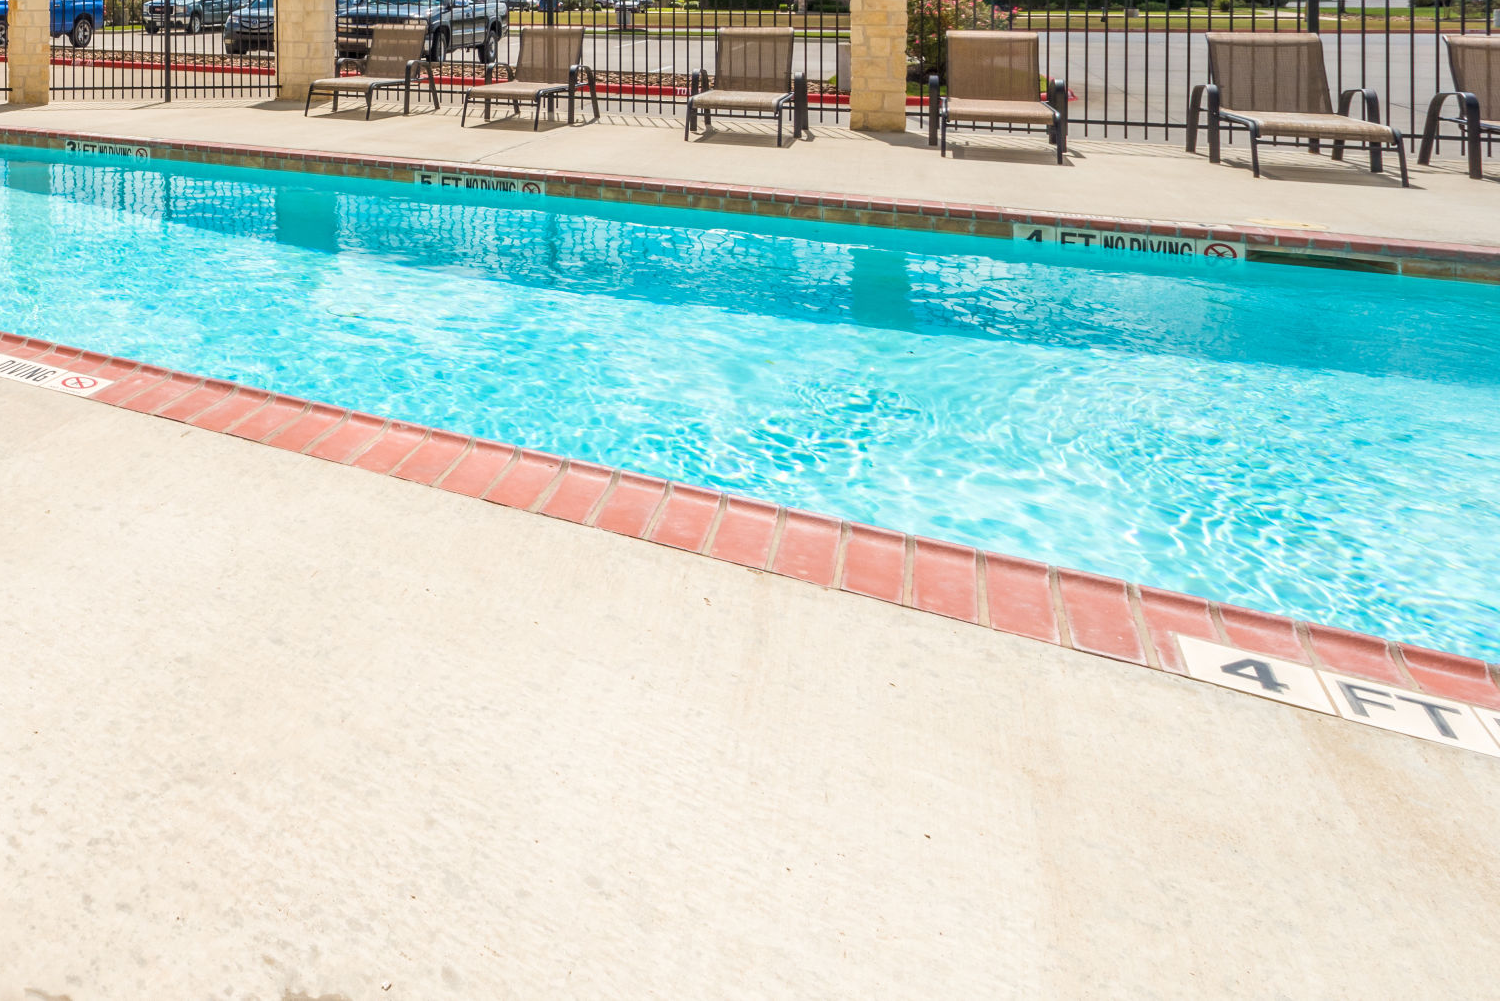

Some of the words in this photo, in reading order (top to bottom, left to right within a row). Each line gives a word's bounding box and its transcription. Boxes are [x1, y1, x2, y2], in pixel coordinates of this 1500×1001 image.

[1103, 235, 1125, 250] NO
[1130, 238, 1193, 257] DIVING
[1220, 658, 1290, 694] 4
[1335, 680, 1462, 740] FT
